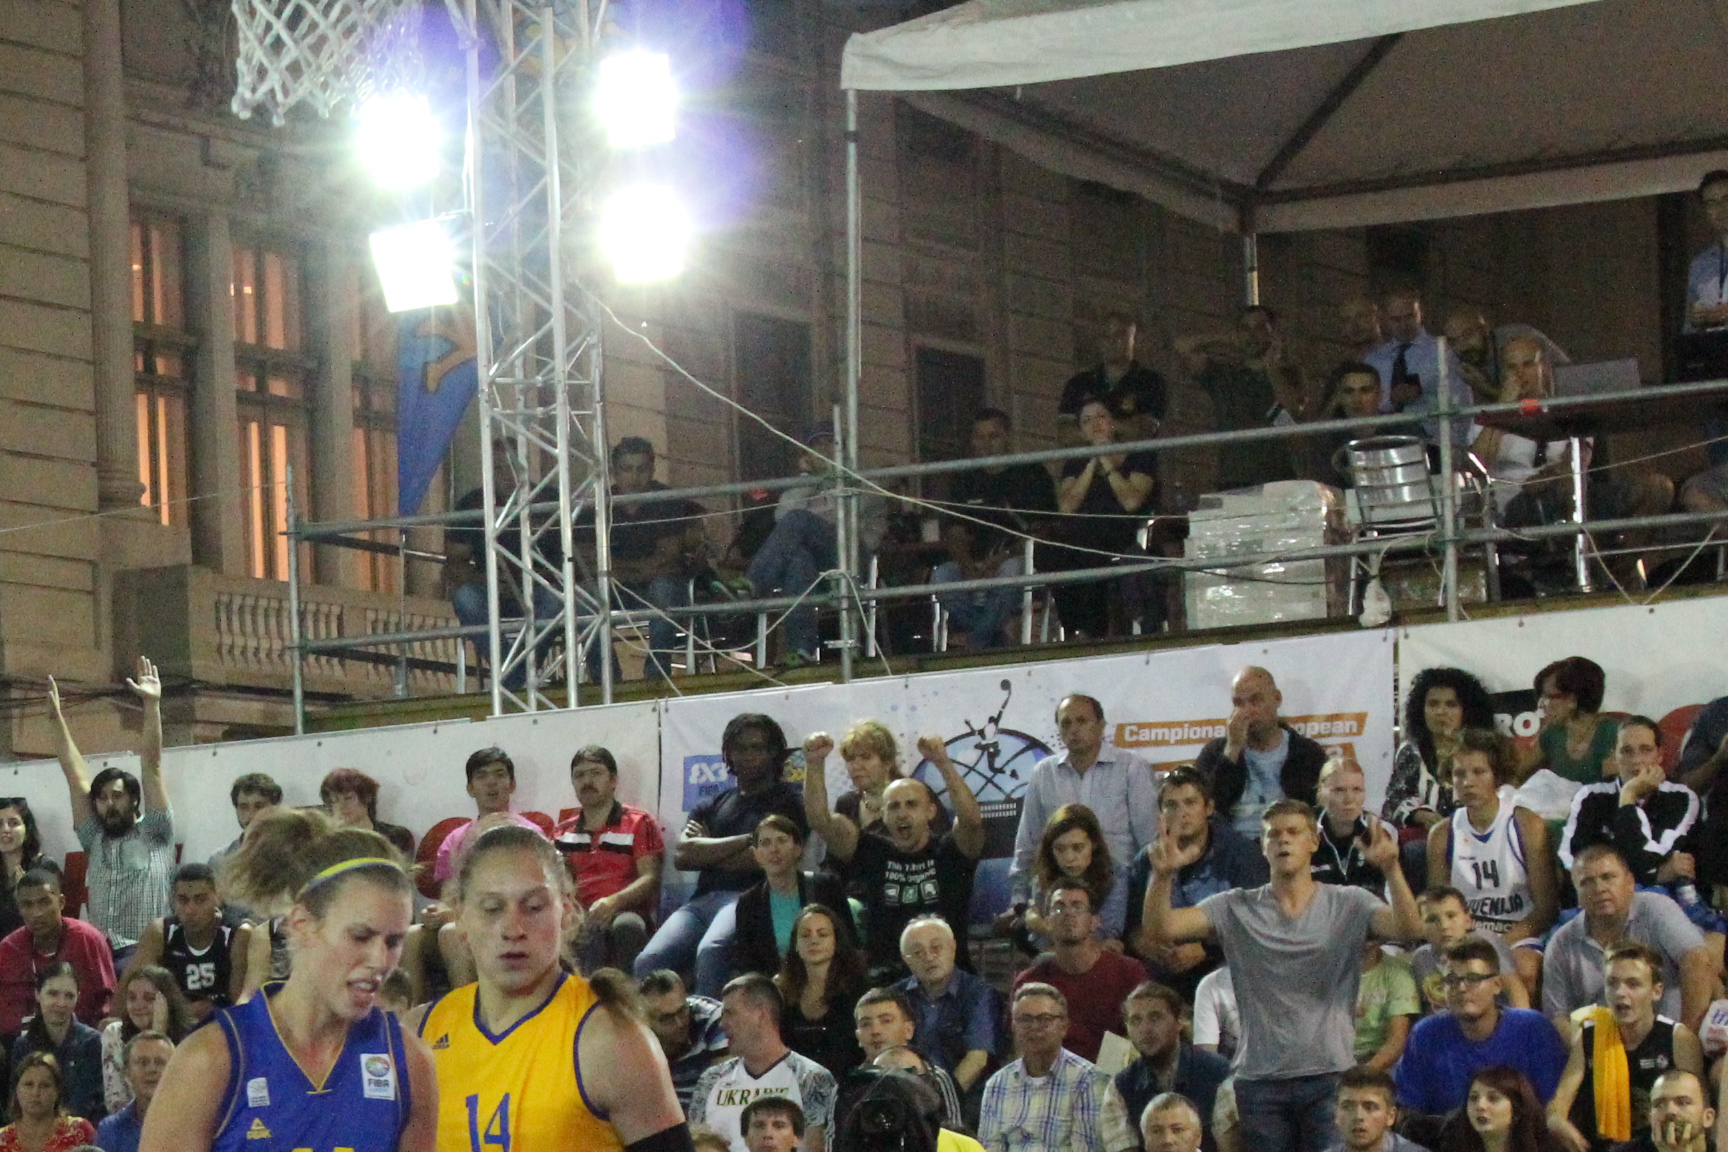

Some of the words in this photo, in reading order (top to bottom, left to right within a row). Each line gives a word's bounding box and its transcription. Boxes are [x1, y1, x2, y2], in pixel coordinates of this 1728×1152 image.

[1124, 724, 1225, 744] Campiona
[1472, 859, 1500, 890] 14
[186, 962, 216, 990] 25
